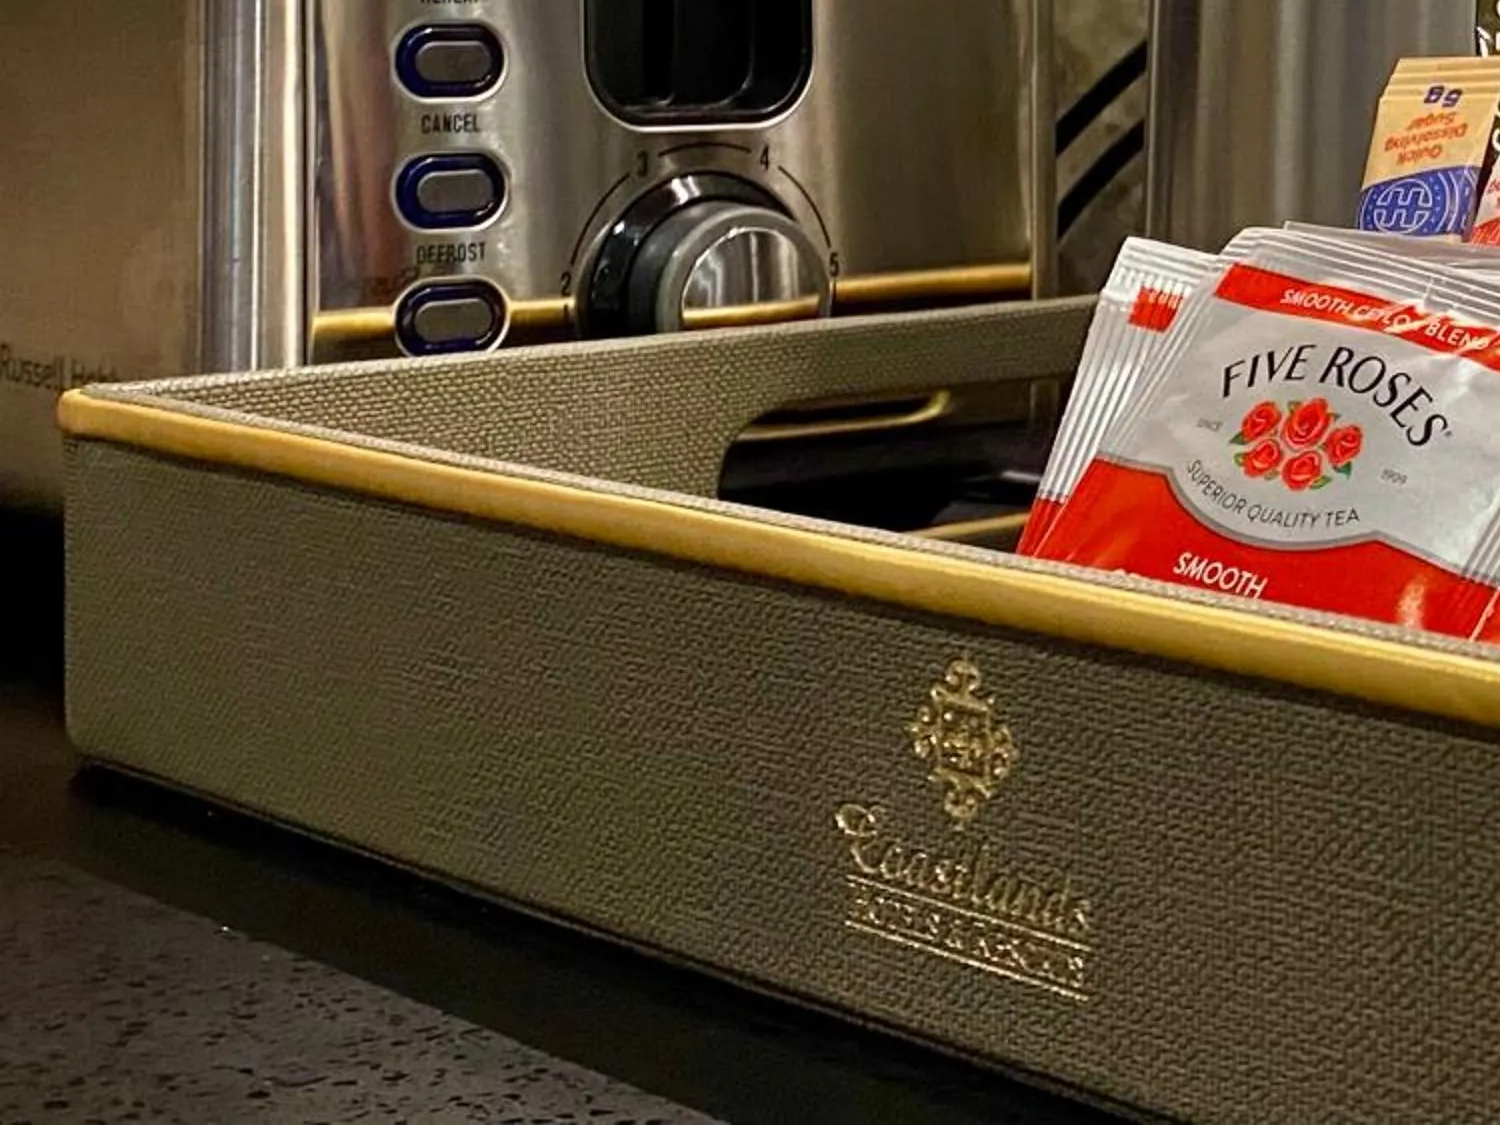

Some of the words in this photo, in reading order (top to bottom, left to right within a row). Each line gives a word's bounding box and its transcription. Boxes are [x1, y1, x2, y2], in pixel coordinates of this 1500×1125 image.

[421, 115, 481, 134] CANCEL
[637, 150, 649, 176] 3
[760, 146, 770, 172] 4
[416, 241, 487, 264] DEFROST
[828, 252, 840, 277] 5
[560, 271, 572, 297] 2
[1279, 288, 1353, 315] SMOOTH
[1221, 344, 1317, 398] FIVE
[1318, 345, 1449, 447] ROSES
[1186, 458, 1248, 515] SUPERIOR
[1247, 503, 1322, 528] QUALITY
[1325, 507, 1361, 527] TEA
[1172, 551, 1269, 599] SMOOTH
